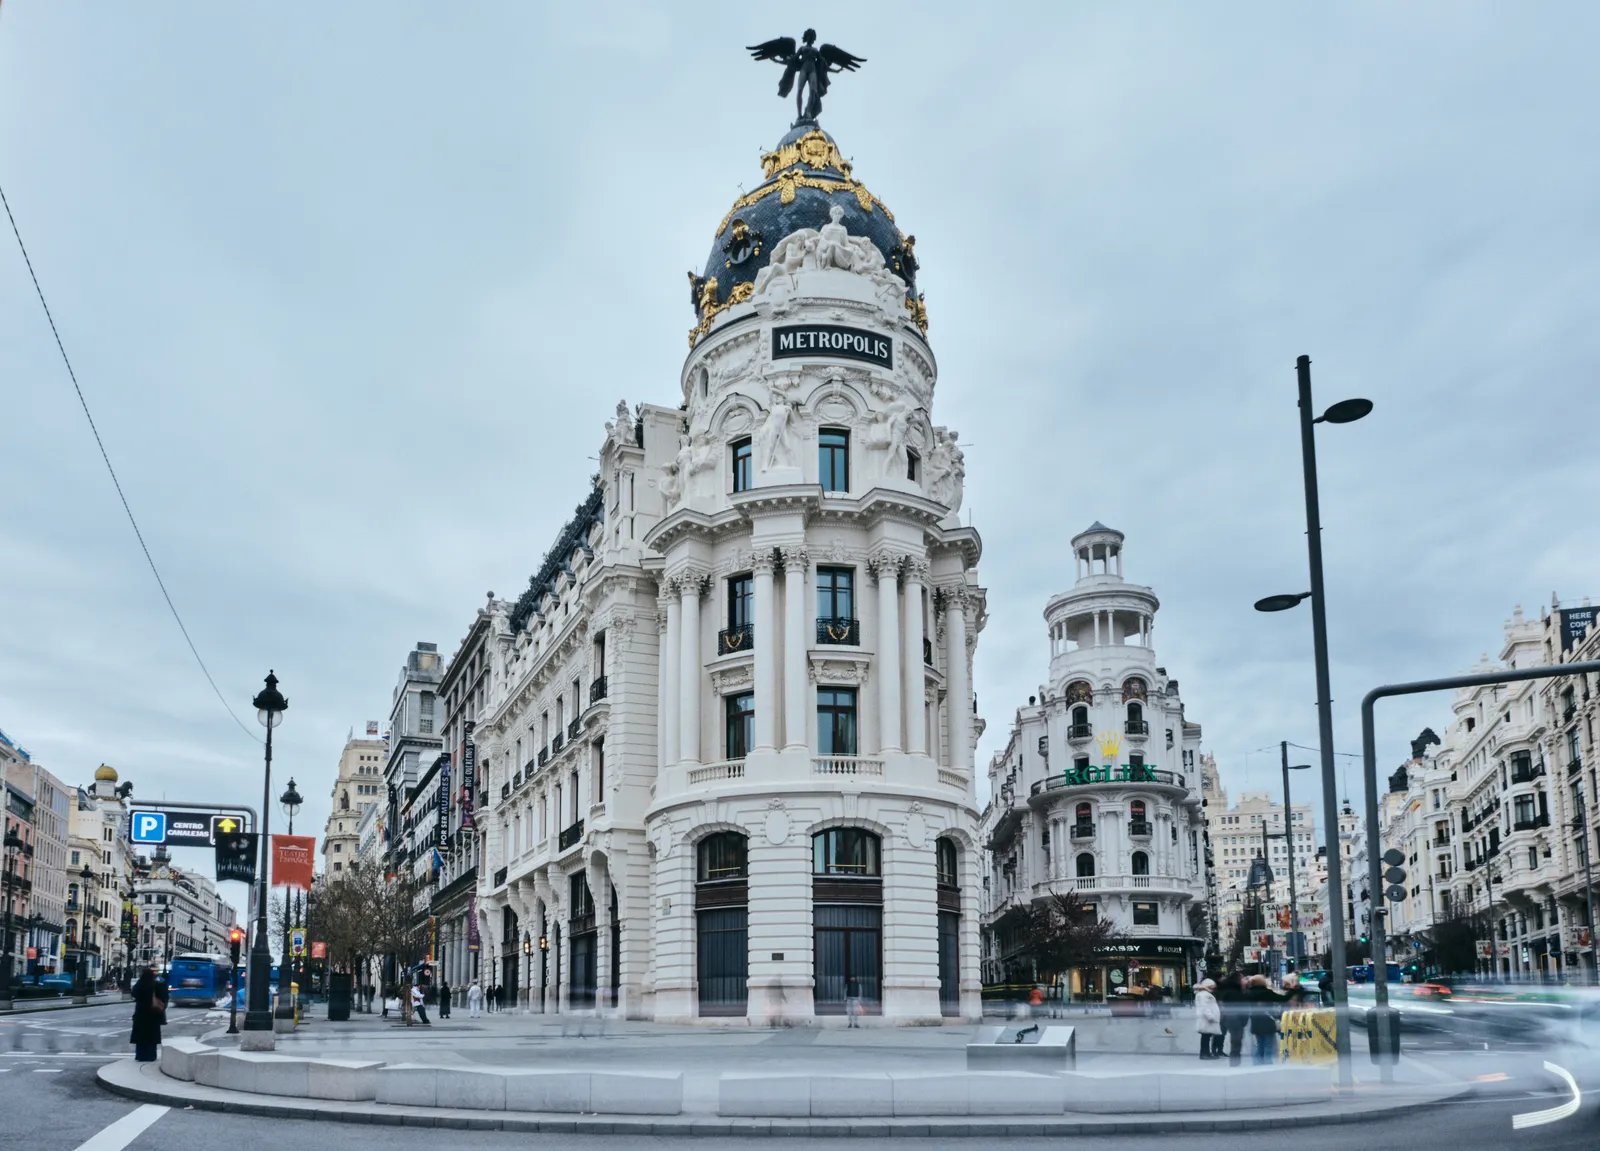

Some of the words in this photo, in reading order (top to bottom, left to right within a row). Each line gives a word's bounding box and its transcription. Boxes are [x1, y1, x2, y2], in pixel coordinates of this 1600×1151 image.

[780, 331, 888, 359] METROPOLIS
[1569, 611, 1592, 620] HERE
[1063, 764, 1157, 786] ROLEX
[441, 777, 449, 814] MUJERES
[140, 816, 158, 838] P
[166, 829, 210, 837] CANALEJAS
[440, 830, 448, 845] POR
